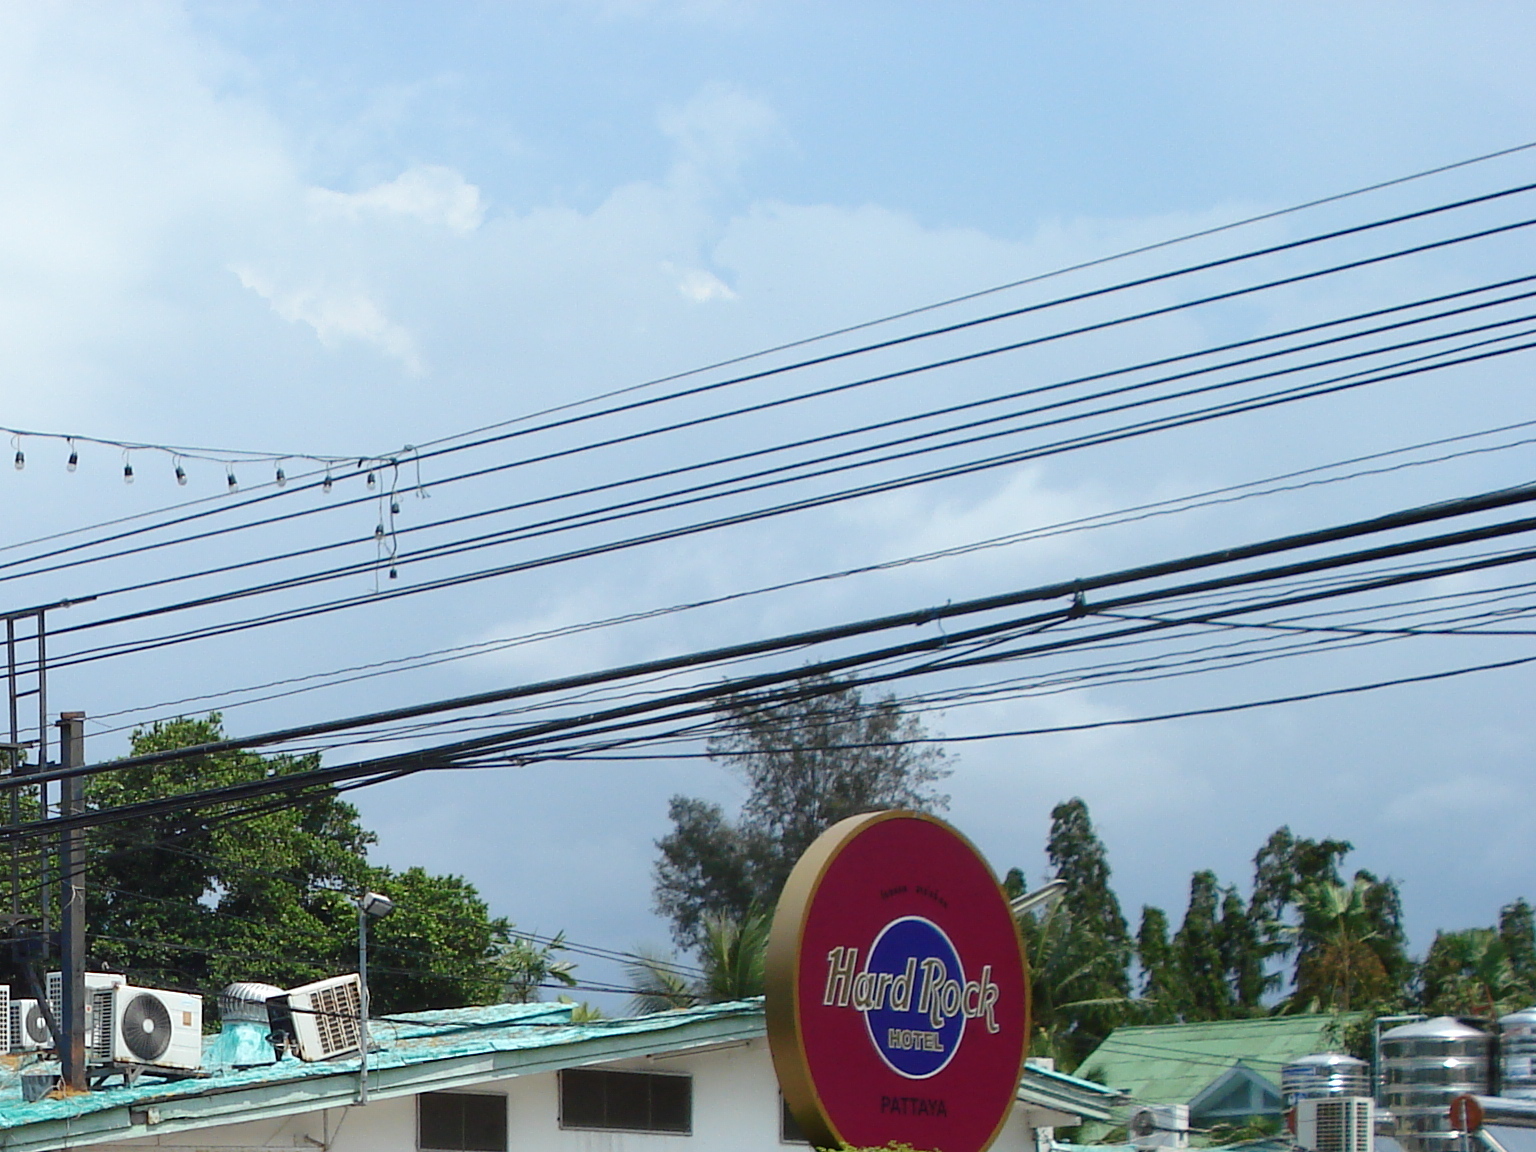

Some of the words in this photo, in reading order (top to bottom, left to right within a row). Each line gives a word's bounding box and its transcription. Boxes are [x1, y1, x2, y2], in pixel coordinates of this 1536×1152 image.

[823, 946, 917, 1012] Hard
[918, 957, 1000, 1034] Rock
[888, 1028, 944, 1052] HOTEL
[880, 1096, 948, 1118] PATTAYA
